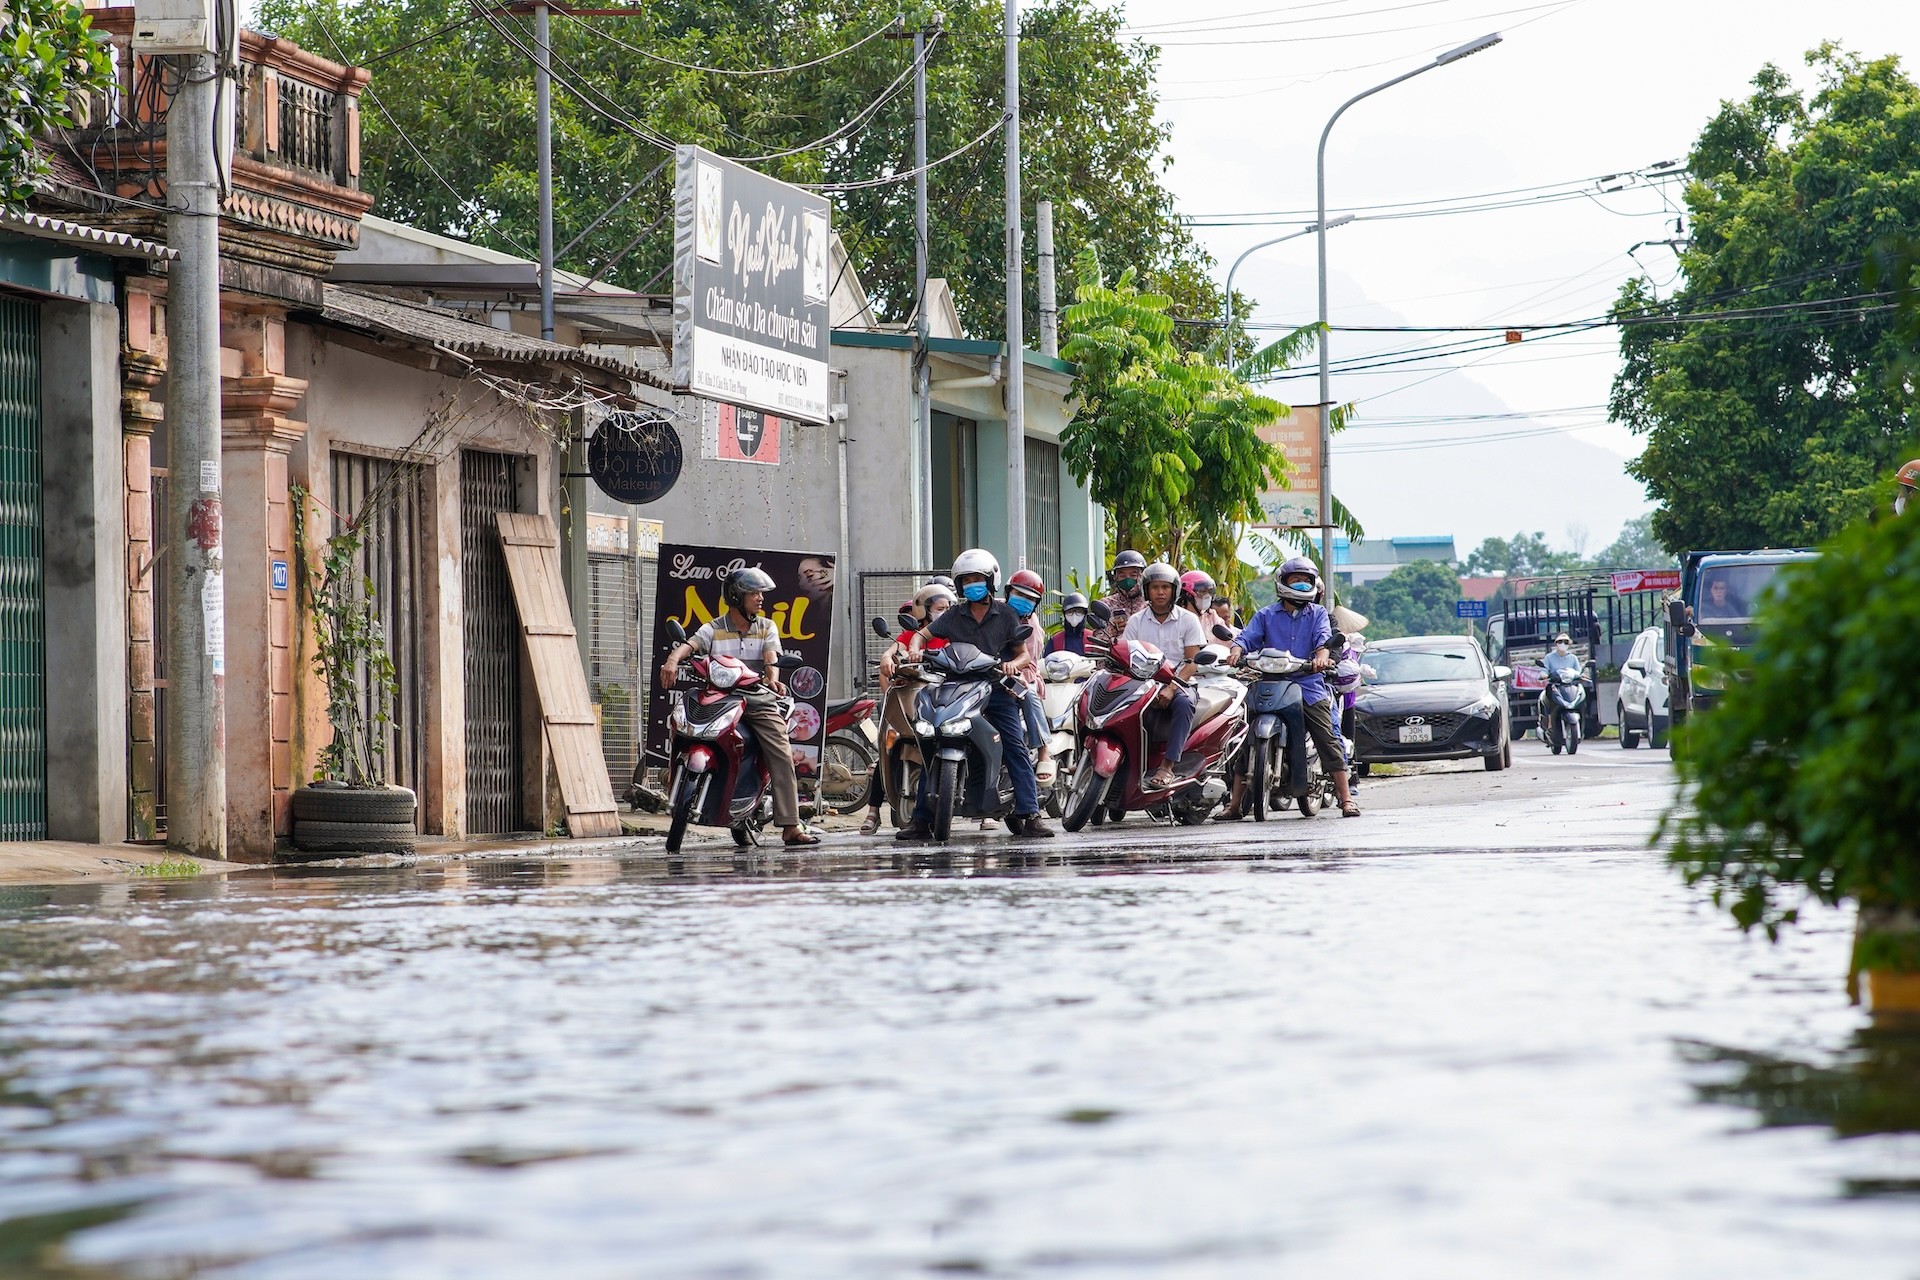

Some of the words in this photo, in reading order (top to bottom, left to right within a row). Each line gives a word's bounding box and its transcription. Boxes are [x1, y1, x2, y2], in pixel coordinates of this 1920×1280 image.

[728, 200, 765, 288] Nail
[706, 286, 733, 324] Chăm
[735, 292, 752, 330] sóc
[753, 302, 765, 334] Da
[767, 304, 799, 348] chuyên
[801, 313, 817, 349] sâu
[721, 344, 741, 374] NHẬN
[742, 349, 758, 375] ĐÀO
[760, 357, 775, 382] TẠO
[776, 361, 791, 387] HỌC
[793, 362, 807, 387] VIÊN
[608, 477, 661, 491] Makeup
[273, 567, 286, 584] 107
[669, 553, 713, 581] Lan
[1409, 727, 1423, 735] 30H
